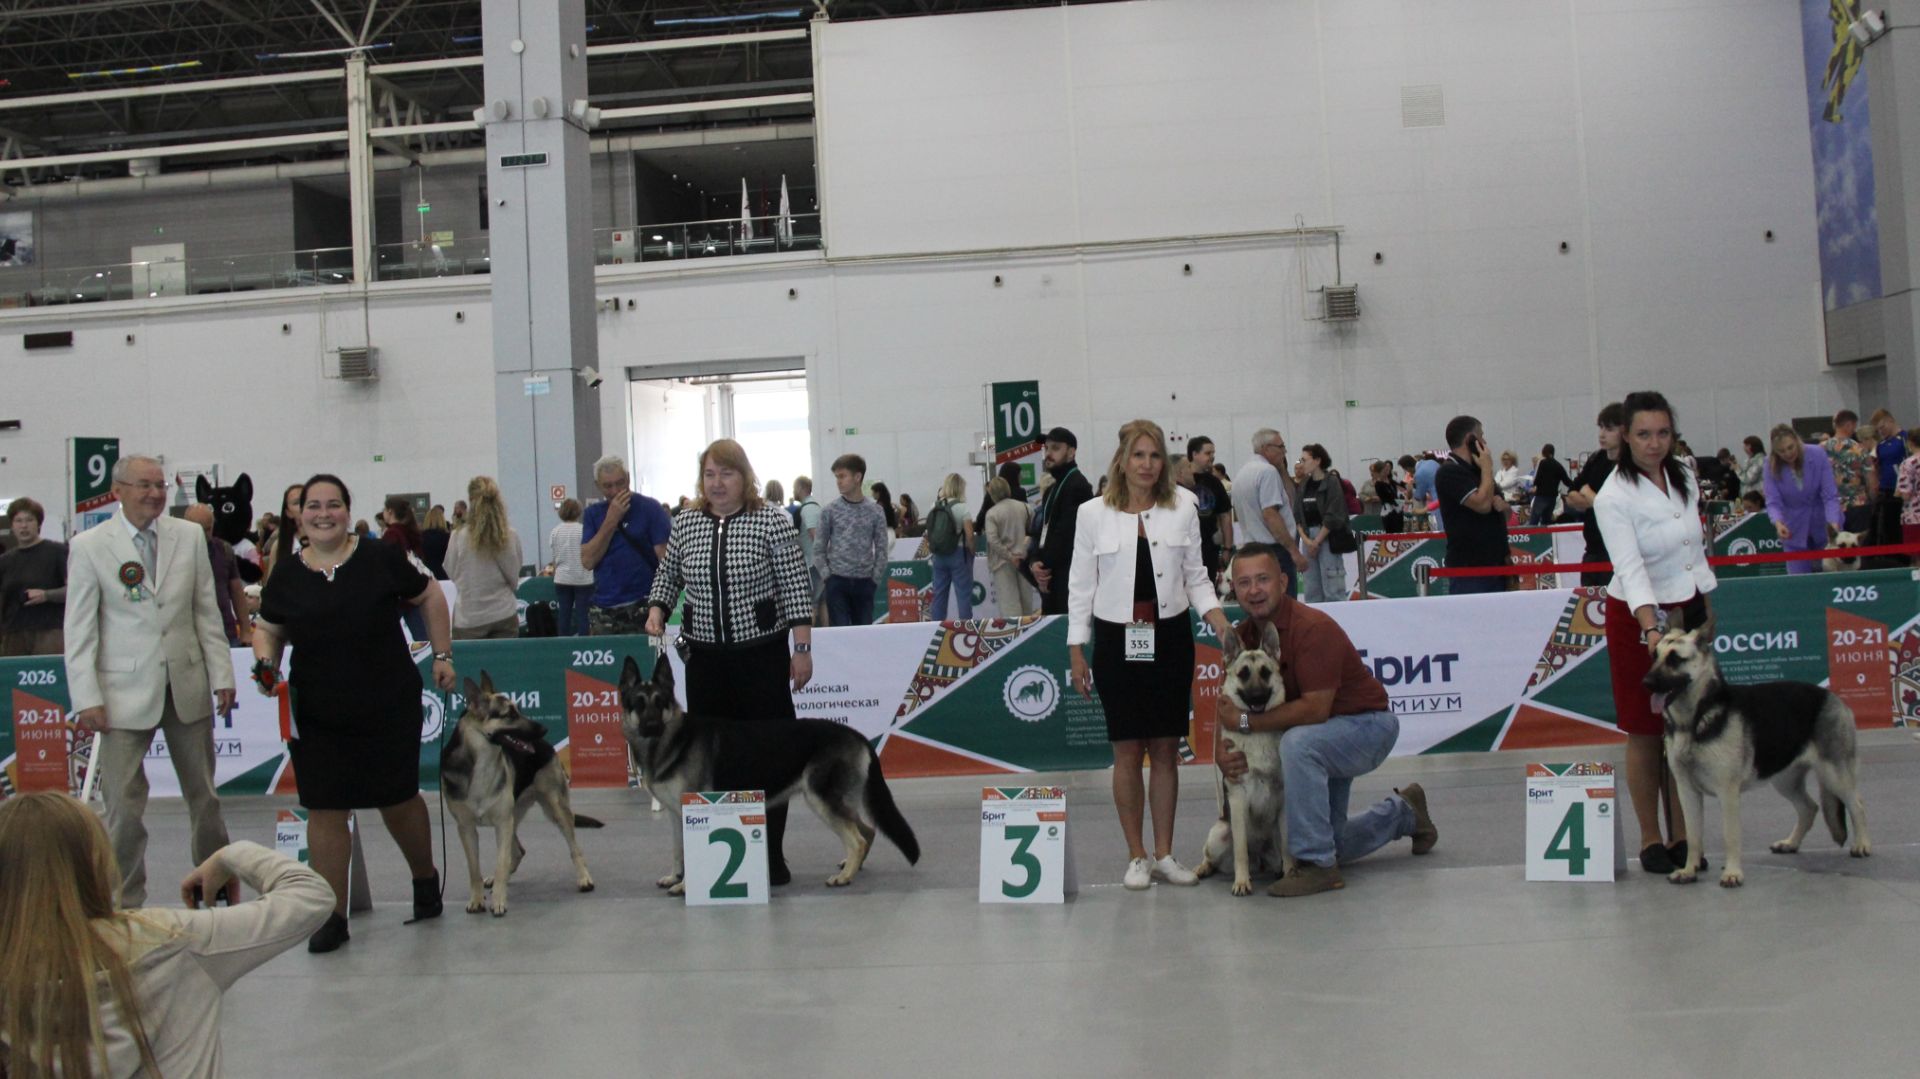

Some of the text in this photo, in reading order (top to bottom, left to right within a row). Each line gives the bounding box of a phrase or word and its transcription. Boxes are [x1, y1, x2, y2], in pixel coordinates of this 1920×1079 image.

[1000, 401, 1034, 437] 10
[88, 454, 106, 488] 9
[1759, 539, 1783, 549] РОС
[890, 567, 913, 576] 2026
[891, 588, 915, 597] 20-21
[1832, 585, 1878, 603] 2026
[1130, 639, 1149, 649] 335
[1713, 630, 1798, 653] ОССИЯ
[1832, 628, 1883, 646] 20-21
[572, 650, 615, 666] 2026
[1835, 650, 1884, 664] ИЮНЯ
[17, 670, 56, 686] 2026
[572, 691, 619, 708] 20-21
[795, 698, 879, 711] нологическая
[1391, 696, 1462, 713] МИУМ
[18, 708, 61, 725] 20-21
[575, 713, 621, 724] ИЮНЯ
[21, 729, 62, 741] ИЮНЯ
[1529, 788, 1554, 799] Брит
[686, 815, 709, 827] Брит
[982, 811, 1006, 823] Брит
[277, 832, 300, 843] Брит
[1544, 802, 1590, 875] 4
[708, 827, 748, 898] 2
[1002, 825, 1041, 898] 3
